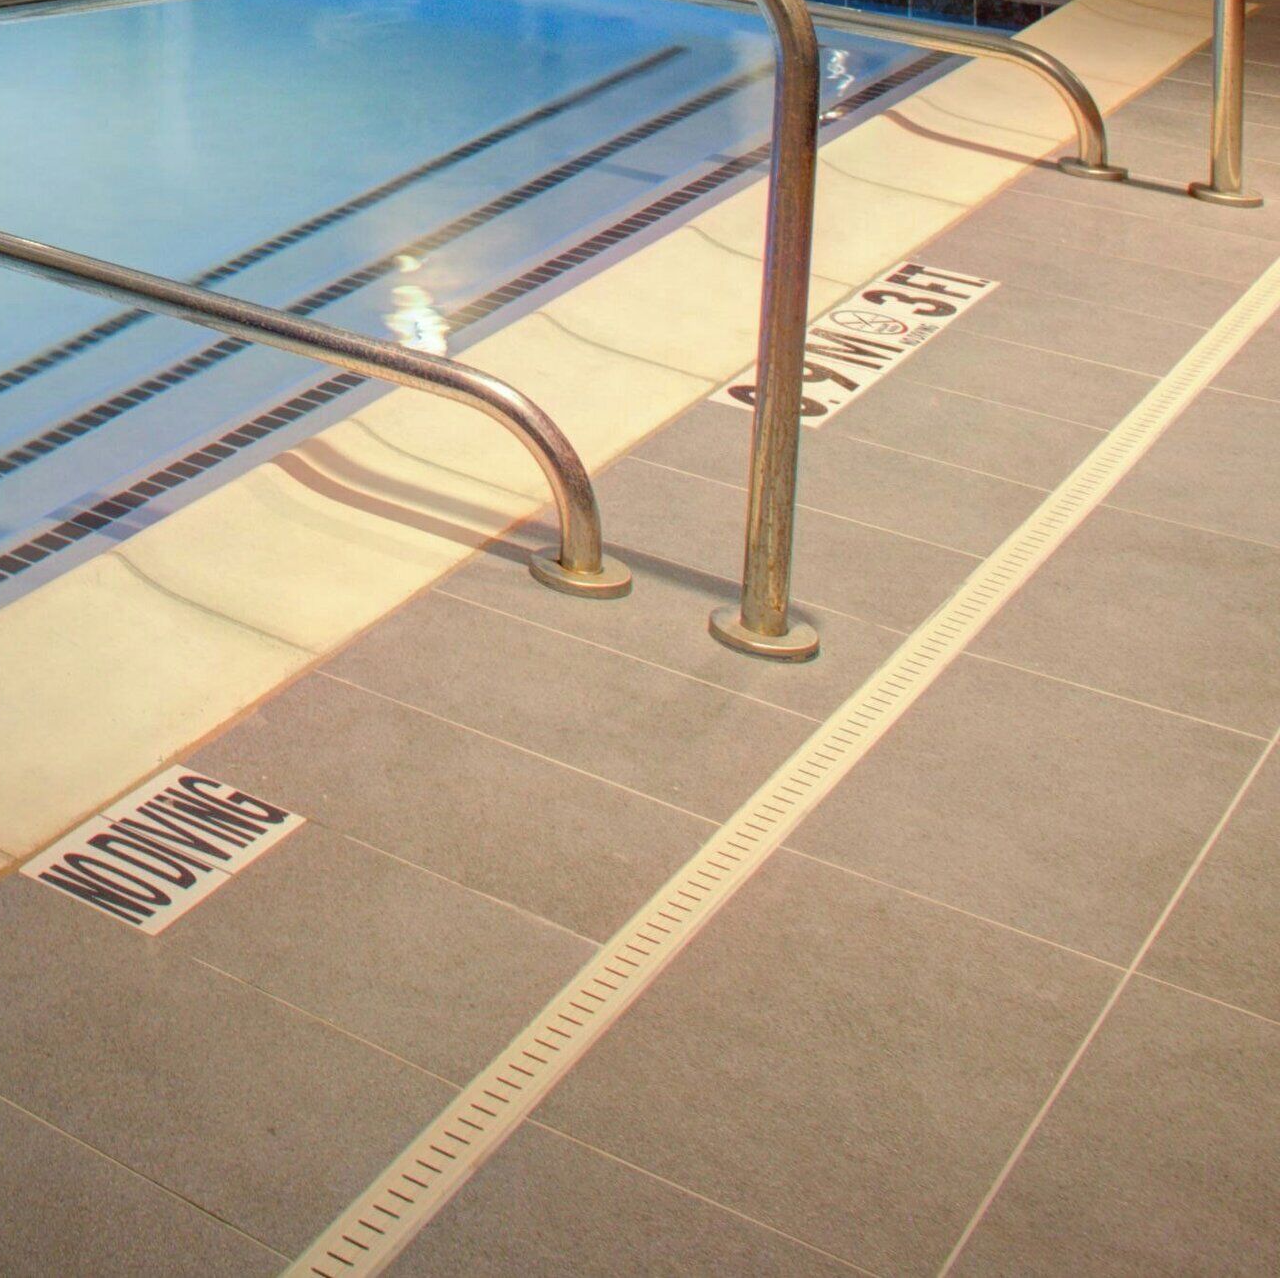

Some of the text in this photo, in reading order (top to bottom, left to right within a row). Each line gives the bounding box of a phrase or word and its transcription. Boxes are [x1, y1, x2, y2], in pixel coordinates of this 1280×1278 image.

[804, 327, 906, 371] M
[862, 288, 958, 318] 3
[37, 774, 290, 926] NO DIVING
